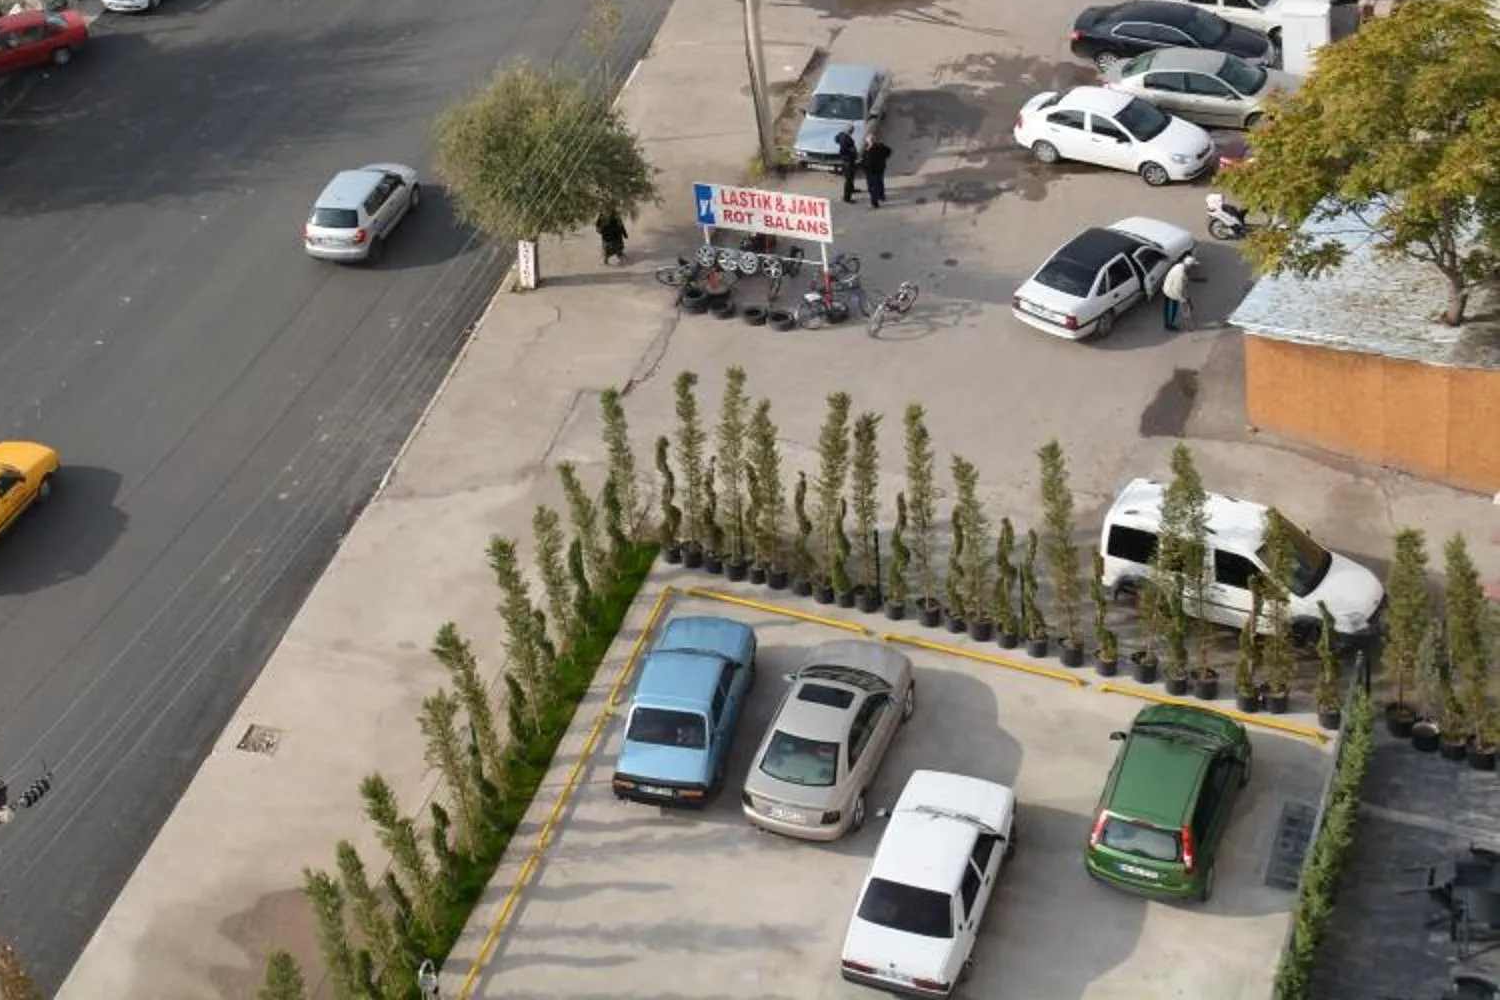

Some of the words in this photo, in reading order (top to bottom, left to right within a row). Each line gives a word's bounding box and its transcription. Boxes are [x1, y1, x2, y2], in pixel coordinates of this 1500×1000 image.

[775, 195, 786, 212] &
[788, 199, 827, 218] JANT
[723, 209, 754, 225] ROT
[763, 214, 829, 236] BALANS
